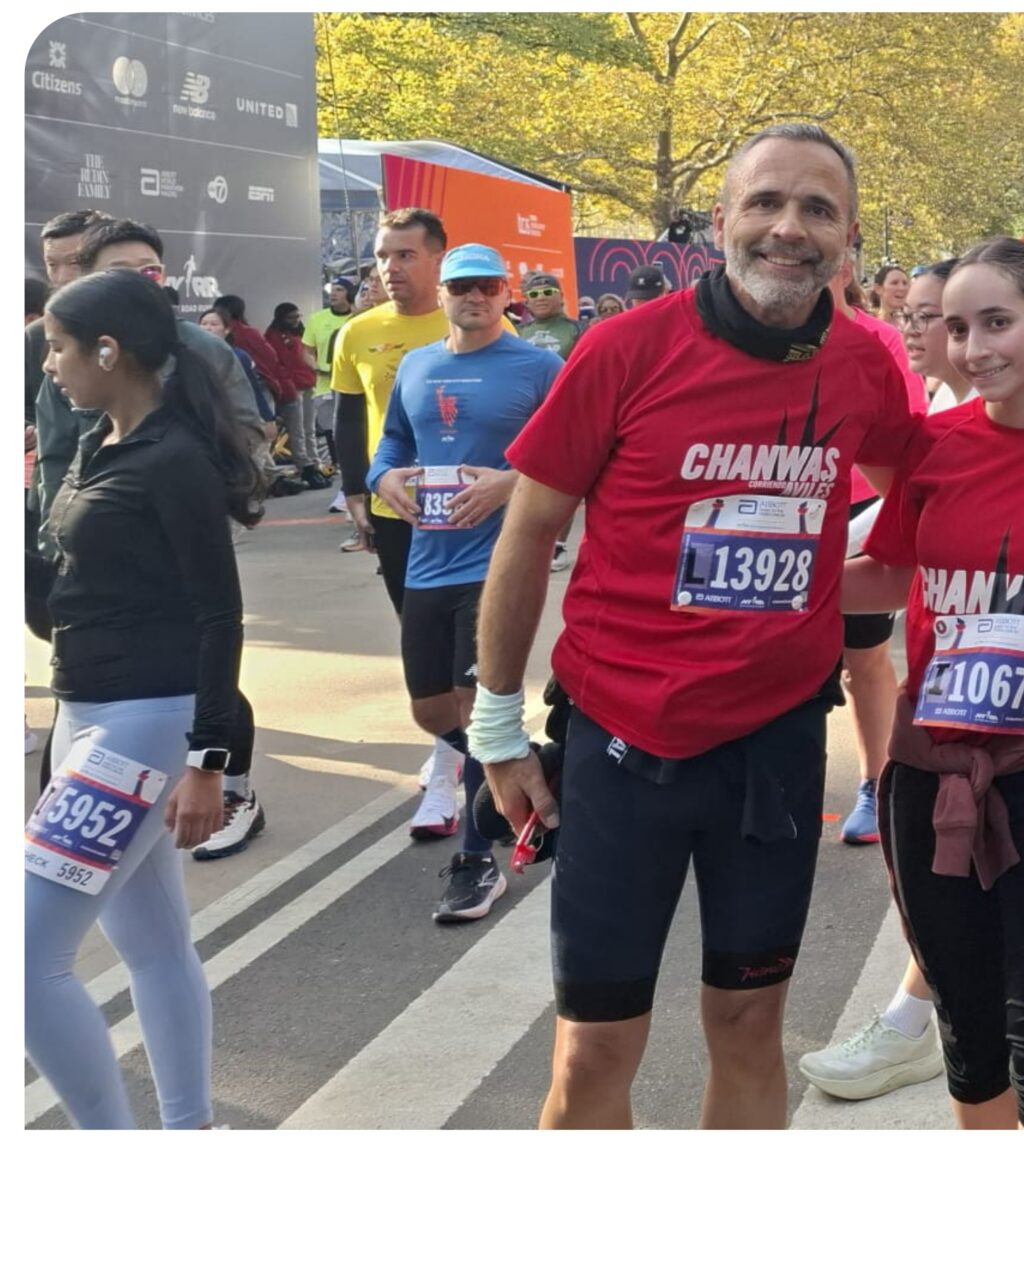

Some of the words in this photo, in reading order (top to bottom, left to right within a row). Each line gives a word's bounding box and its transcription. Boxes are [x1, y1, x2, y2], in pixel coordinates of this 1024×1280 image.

[32, 70, 82, 96] Citizens
[236, 97, 284, 119] UNITED
[248, 186, 274, 202] ESPN
[680, 442, 841, 483] CHANWAS
[684, 546, 706, 585] L
[710, 545, 813, 592] 13928
[48, 786, 133, 847] 5952
[57, 862, 94, 887] 5952
